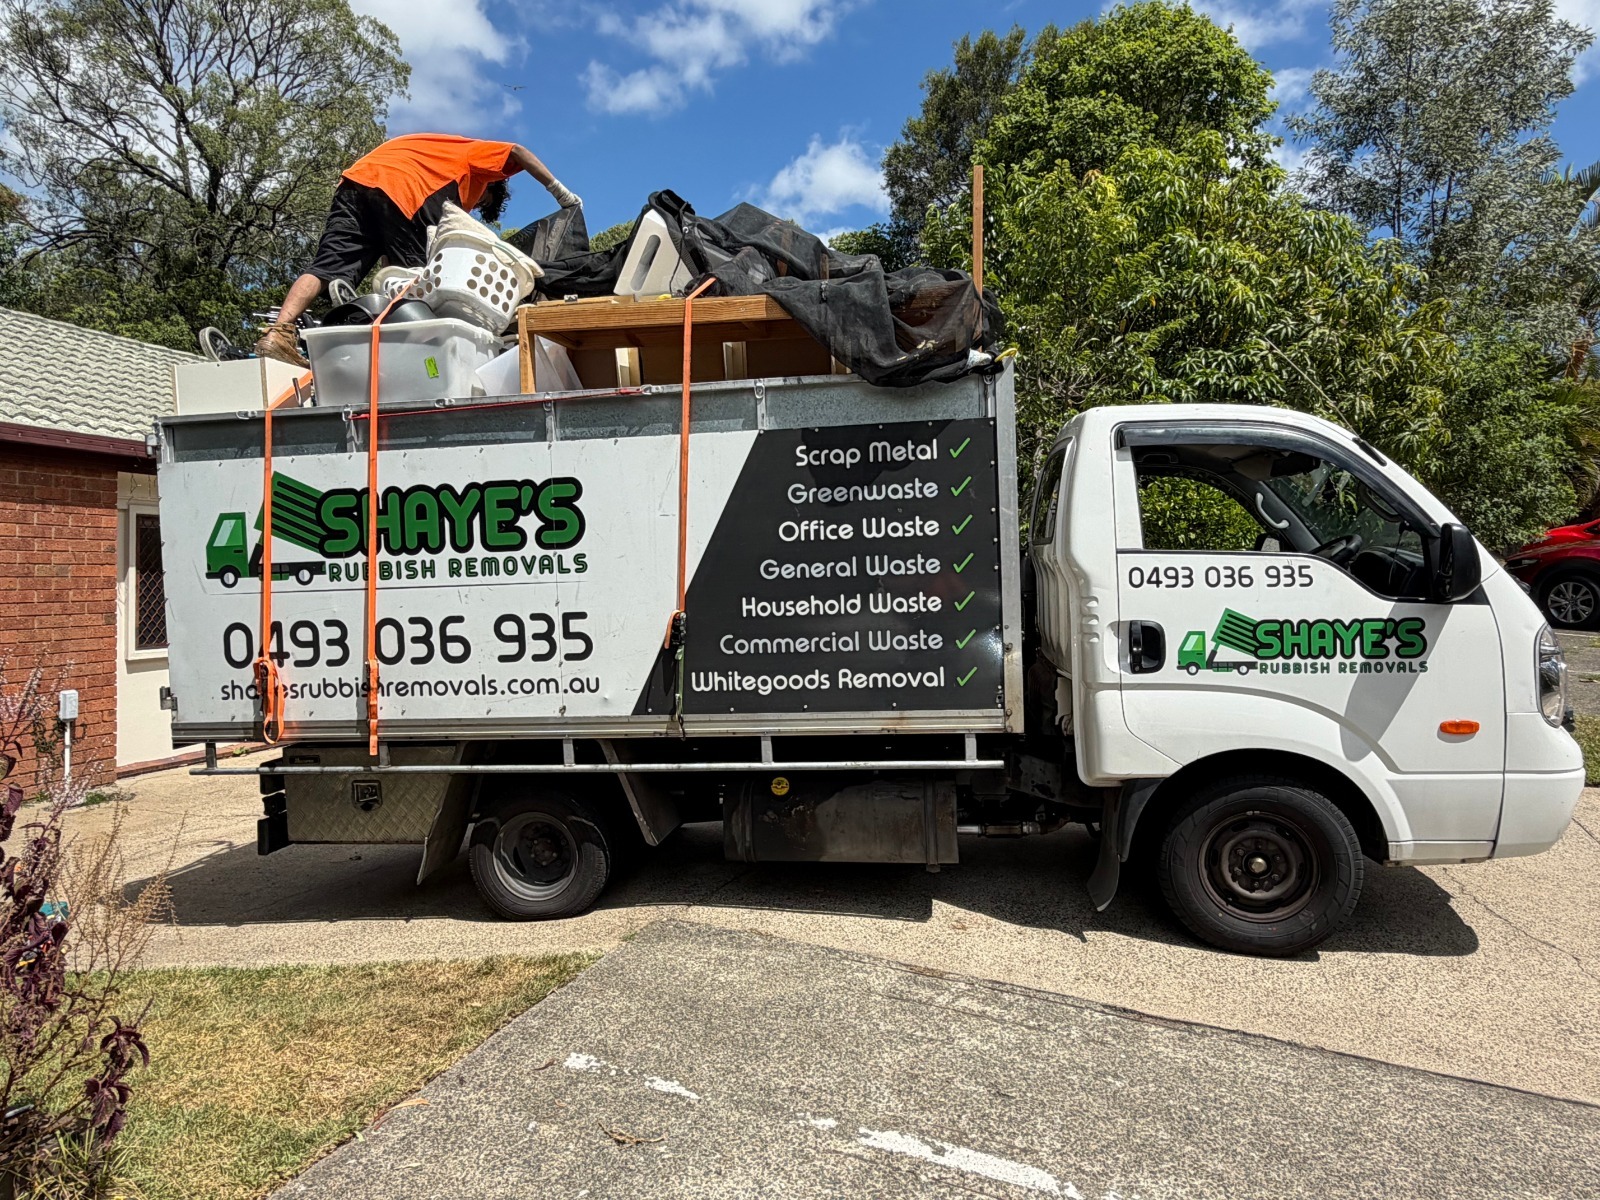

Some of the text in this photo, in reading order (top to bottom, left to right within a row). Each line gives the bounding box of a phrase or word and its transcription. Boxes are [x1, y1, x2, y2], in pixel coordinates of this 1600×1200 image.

[795, 439, 938, 469] Scrap Metal
[787, 477, 939, 503] Greenwaste
[316, 477, 586, 558] SHAYE'S
[778, 516, 940, 542] Office Waste
[328, 553, 588, 582] RUBBISH REMOVALS
[759, 554, 941, 580] General Waste
[1128, 564, 1314, 588] 0493 036 935
[742, 592, 942, 618] Household Waste
[223, 611, 594, 669] 0493 036 935
[719, 629, 943, 654] Commercial Waste
[1253, 617, 1427, 660] SHAYE'S
[691, 666, 945, 695] Whitegoods Removal
[1259, 660, 1429, 675] RUBBISH REMOVALS
[221, 674, 600, 701] shaesrubbisremovals.com.au
